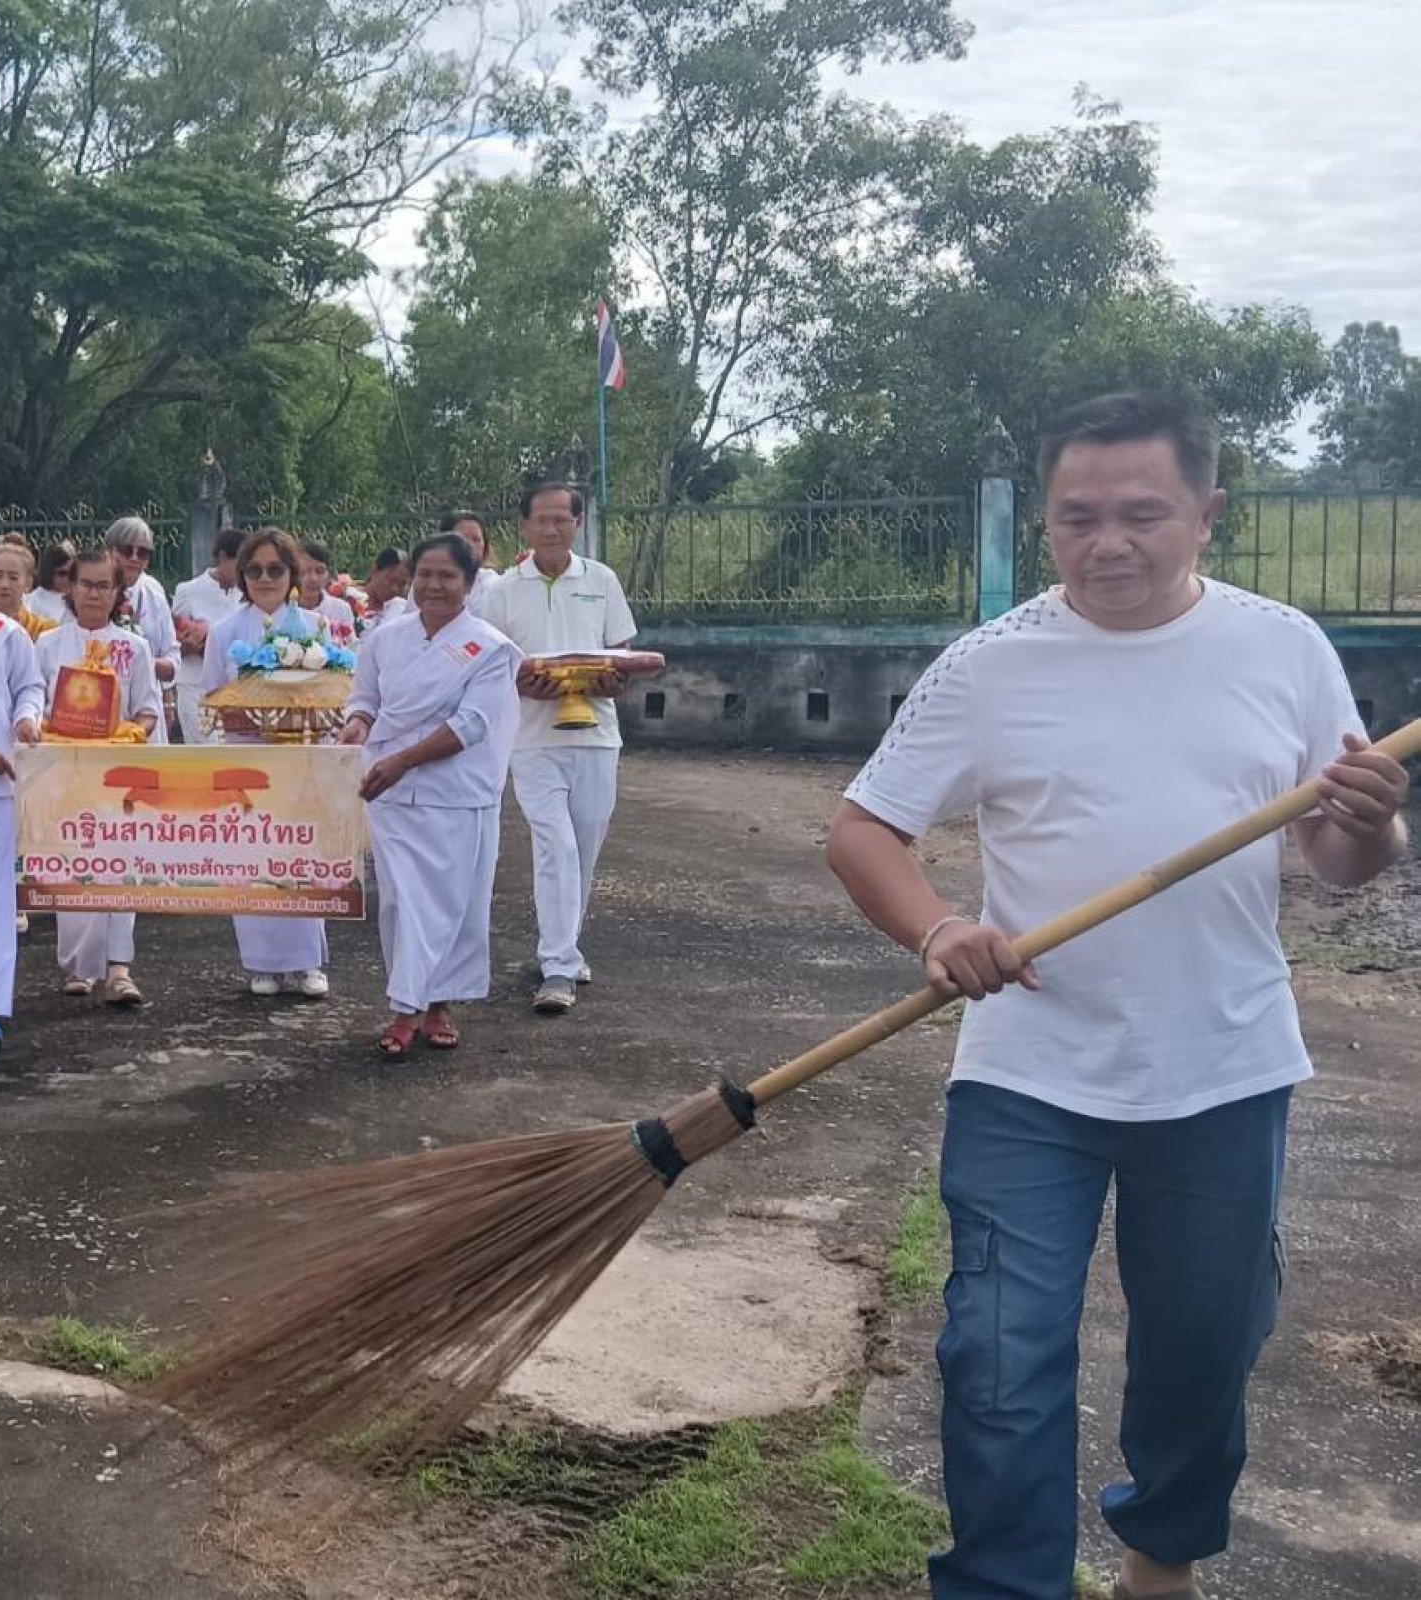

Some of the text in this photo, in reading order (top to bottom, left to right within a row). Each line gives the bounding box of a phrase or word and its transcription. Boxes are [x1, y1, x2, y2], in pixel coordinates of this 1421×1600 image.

[61, 806, 314, 849] กฐินสามัคคีทั่วไทย
[26, 856, 353, 881] ๓๐,๐๐๐ วัด พุทธศักราช ๒๕๖๘
